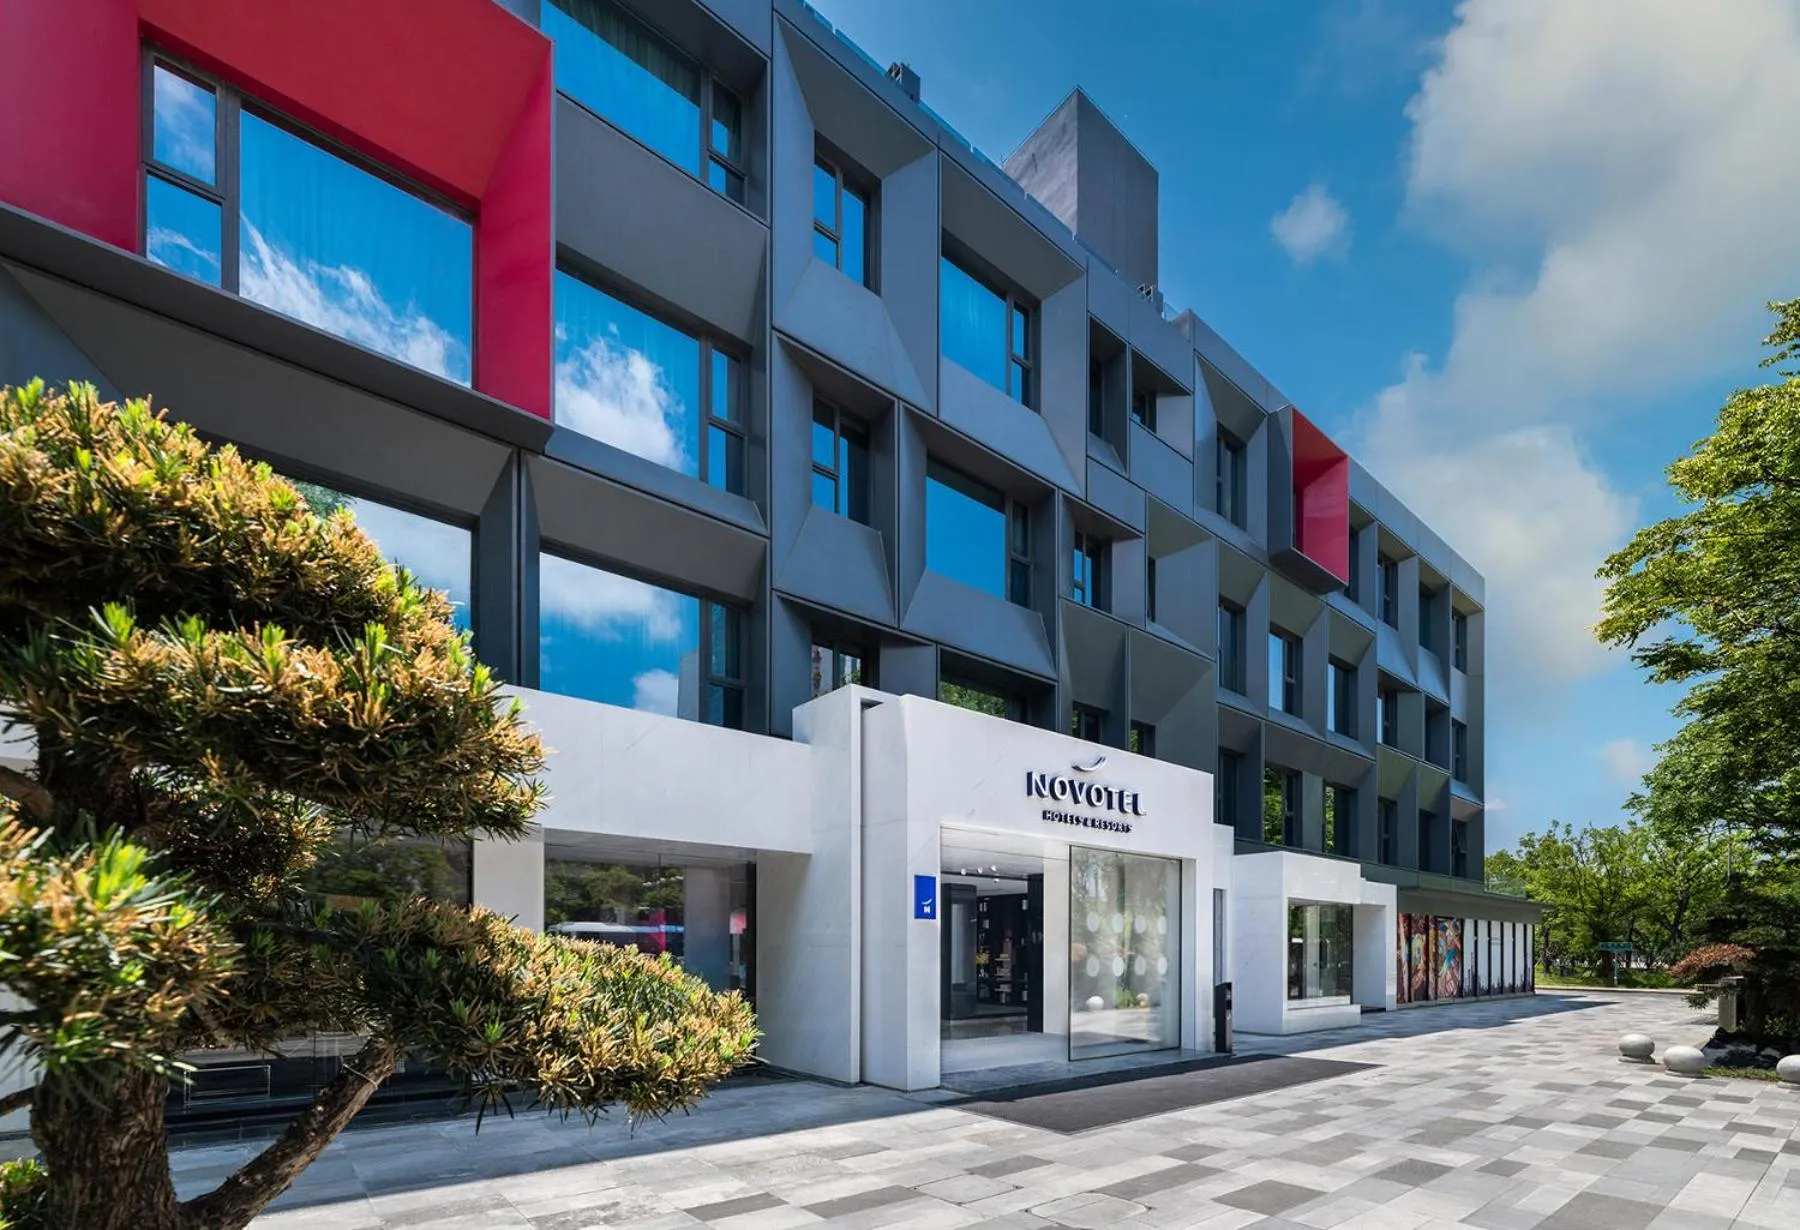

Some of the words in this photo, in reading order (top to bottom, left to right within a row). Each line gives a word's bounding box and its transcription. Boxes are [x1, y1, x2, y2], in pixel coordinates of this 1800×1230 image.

[1026, 771, 1147, 816] NOVOTEL
[1042, 810, 1081, 826] HOTELS
[1091, 818, 1133, 833] RESORTS
